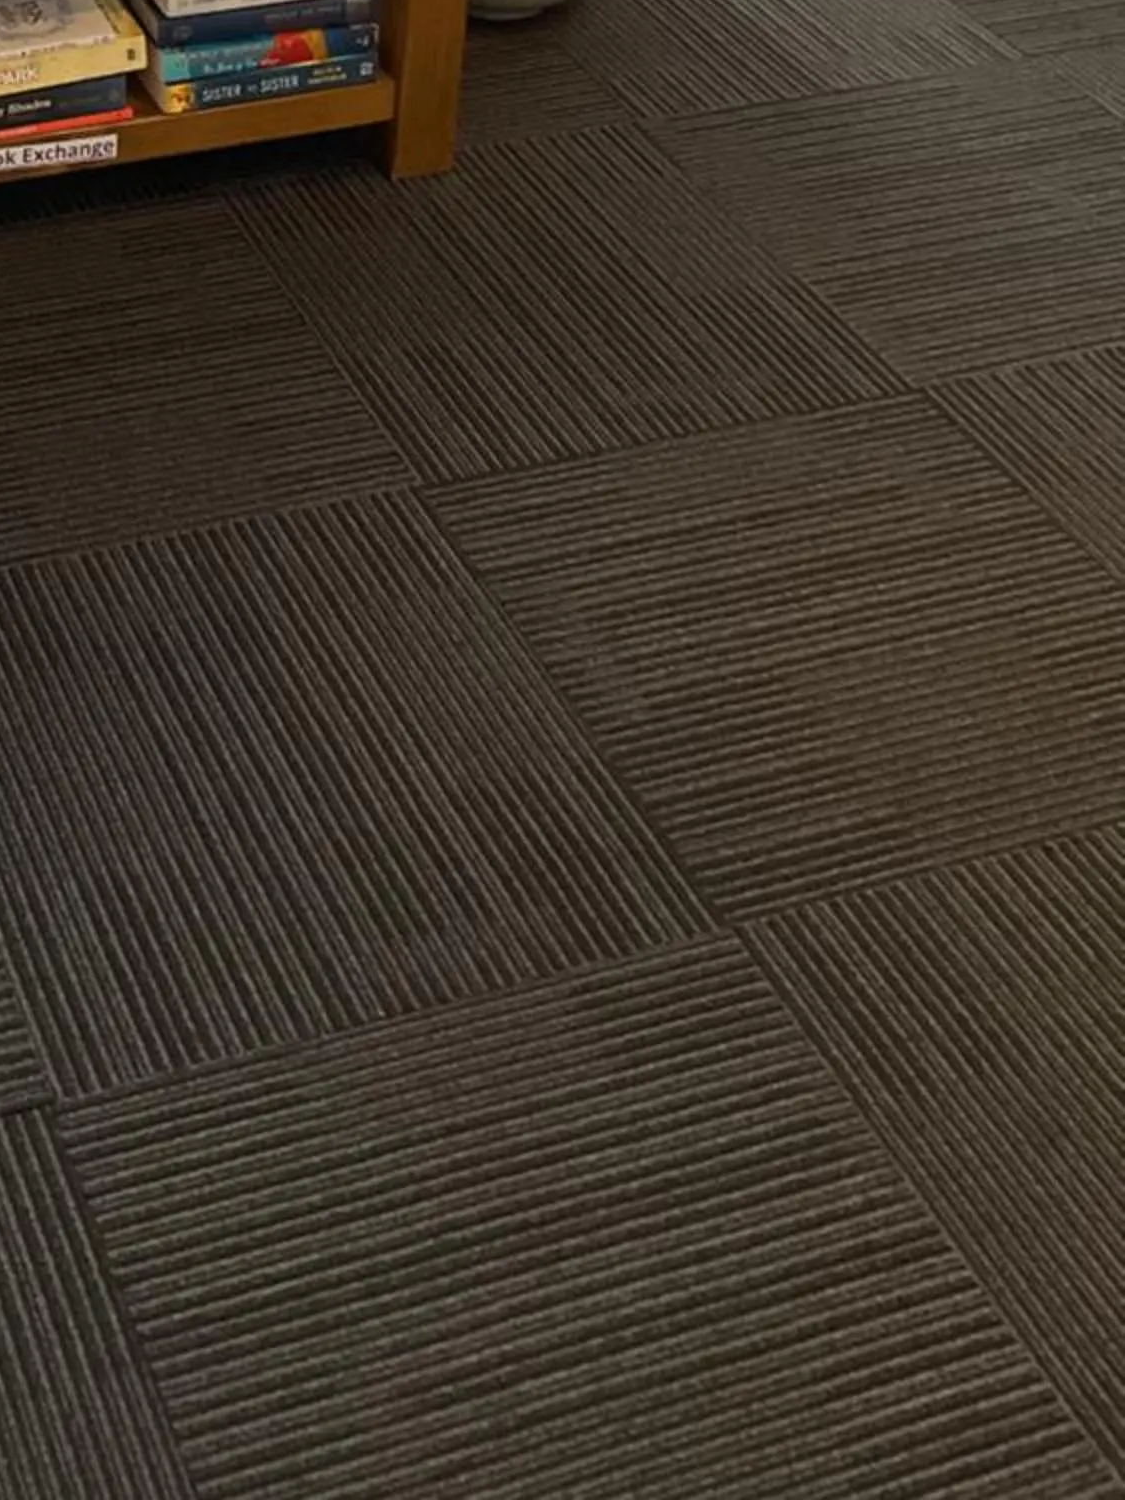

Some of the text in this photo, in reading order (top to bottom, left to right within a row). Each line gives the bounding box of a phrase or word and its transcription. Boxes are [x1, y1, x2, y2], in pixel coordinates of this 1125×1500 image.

[202, 84, 243, 102] SISTER
[260, 74, 300, 92] SISTER
[22, 138, 115, 163] Exchange
